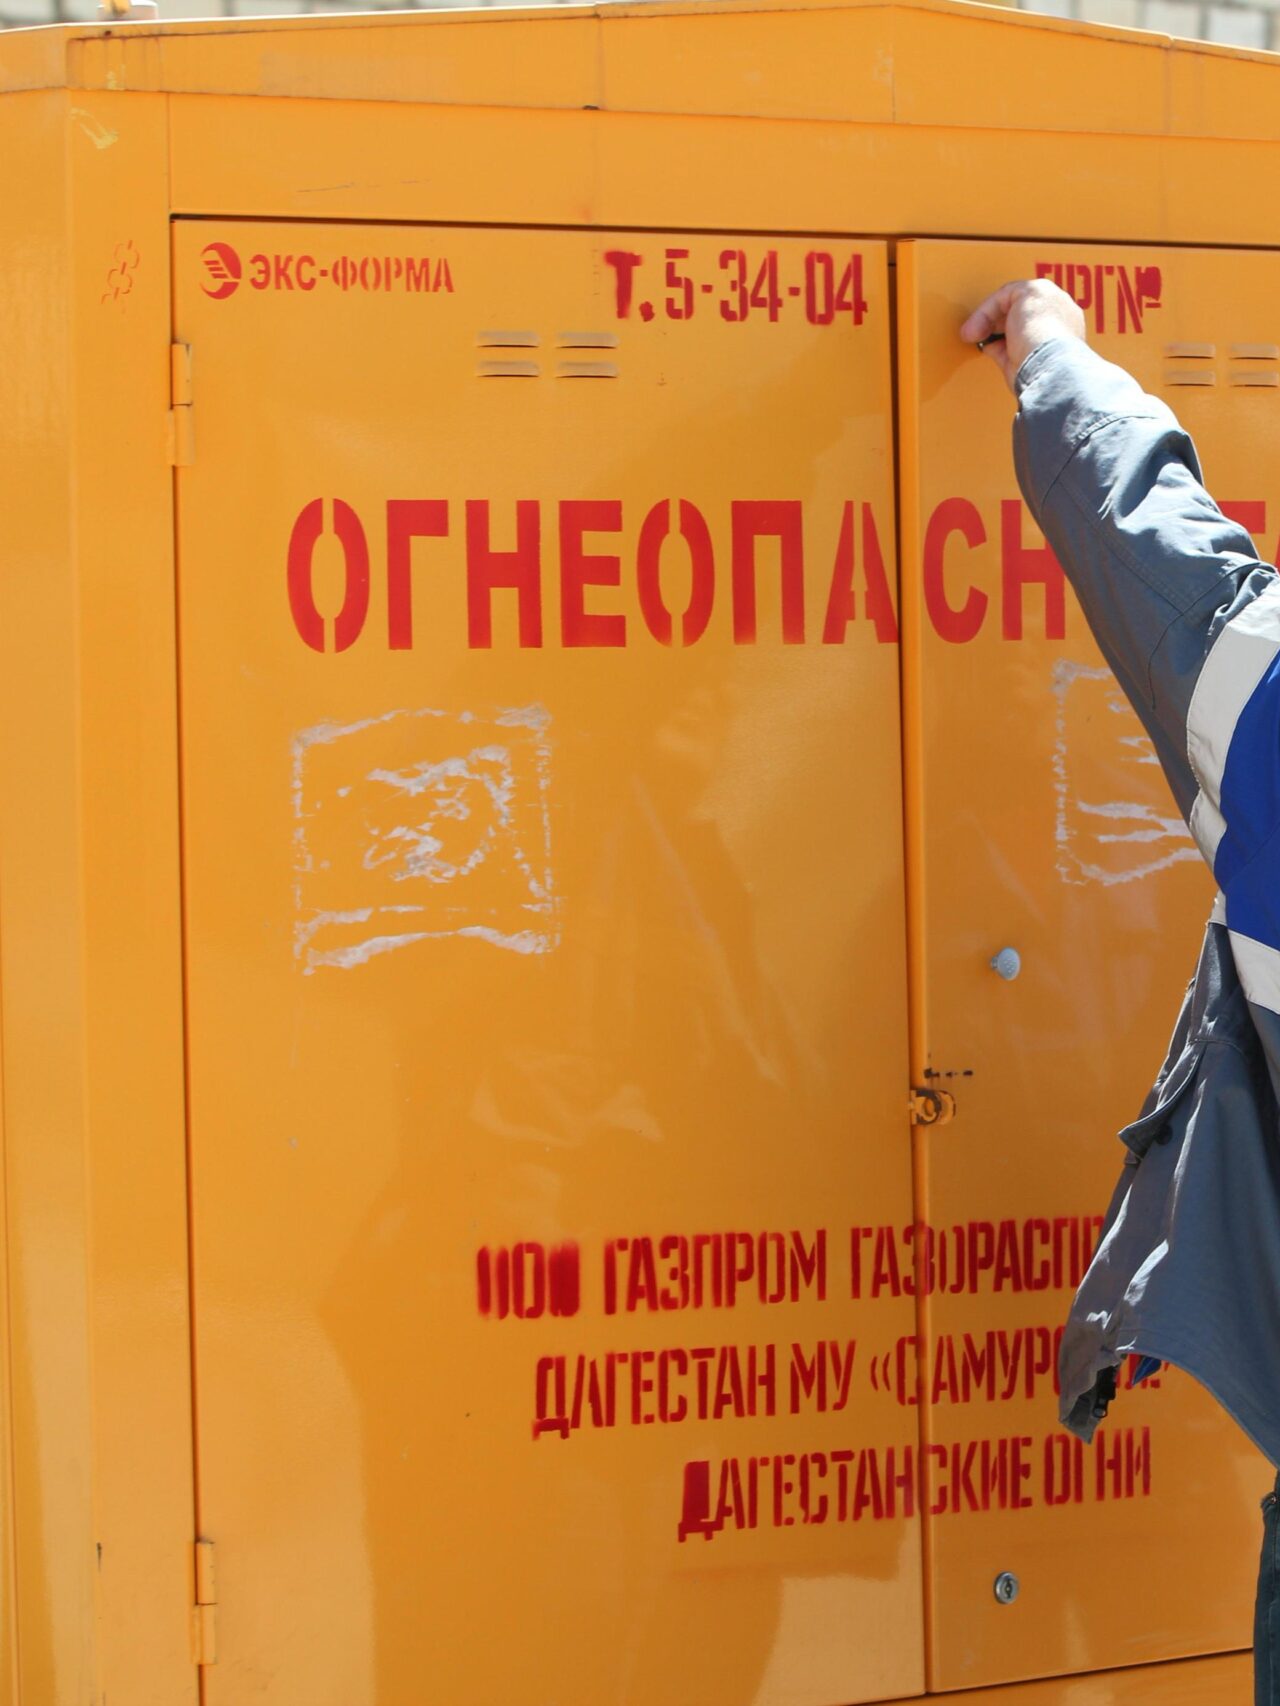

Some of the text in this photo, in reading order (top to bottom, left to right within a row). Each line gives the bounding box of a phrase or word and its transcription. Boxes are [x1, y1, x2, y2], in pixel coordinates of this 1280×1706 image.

[250, 254, 454, 294] ЭКС-ФОРМА
[287, 497, 1068, 654] ОГНЕОПАСН
[603, 1228, 827, 1315] ГАЗПРОМ
[532, 1343, 776, 1440] ДАГЕСТАН
[790, 1341, 857, 1413] МУ
[678, 1436, 1033, 1543] ДАГЕСТАНСКИЕ
